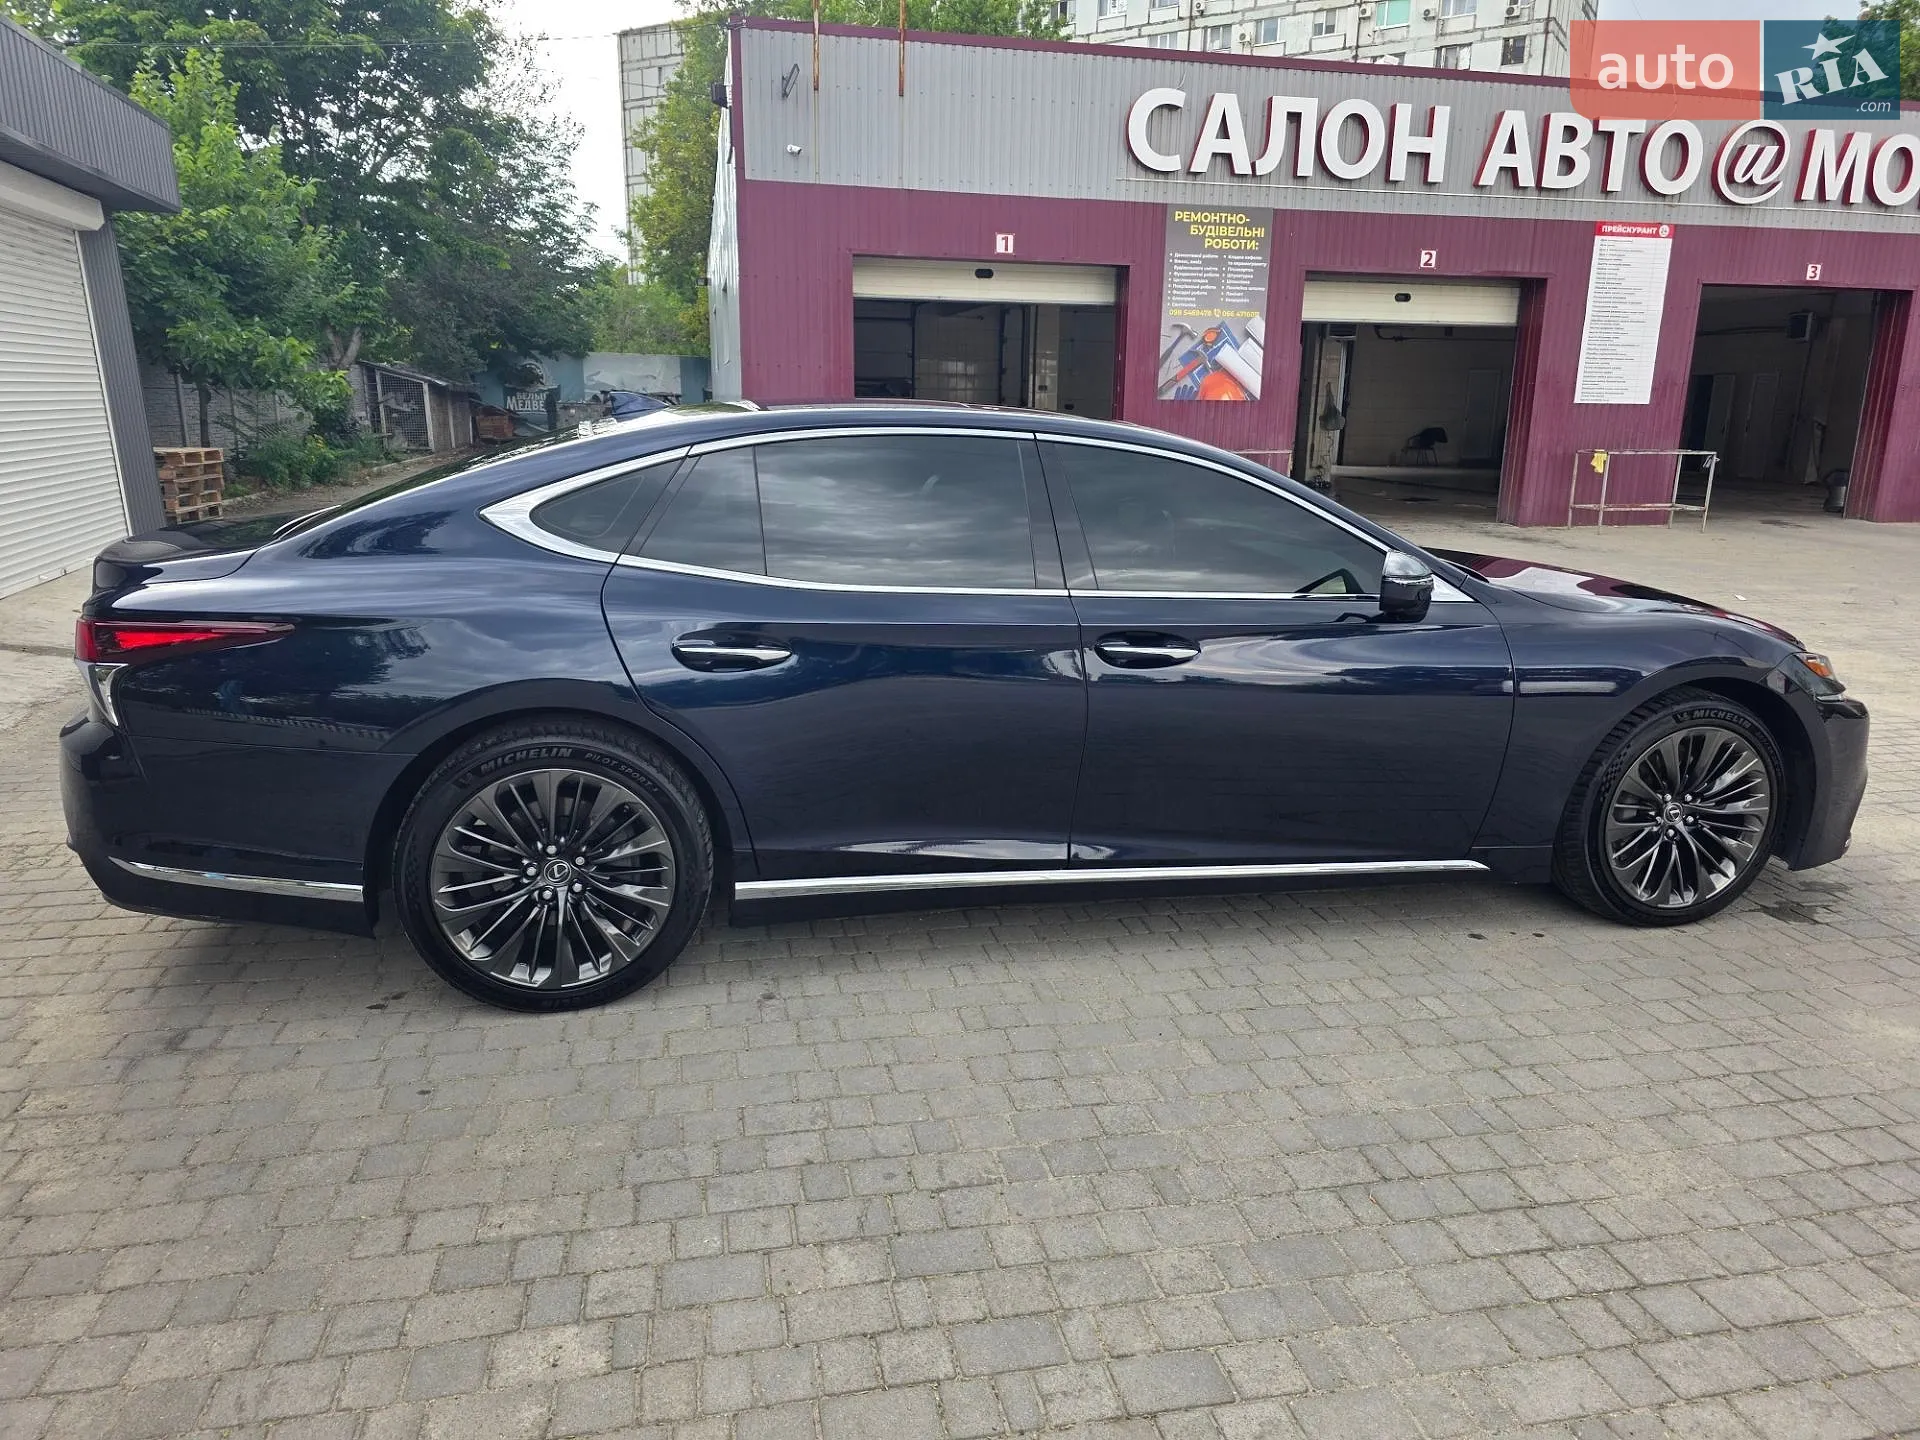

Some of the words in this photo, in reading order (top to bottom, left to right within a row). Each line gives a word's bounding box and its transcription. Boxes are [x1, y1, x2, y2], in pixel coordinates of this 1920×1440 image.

[1126, 86, 1451, 184] САЛОН
[1174, 211, 1250, 224] РЕМОНТНО-
[1190, 224, 1265, 238] БУДІВЕЛЬНІ
[1601, 224, 1658, 235] ПРЕЙСКУРАНТ
[1001, 235, 1009, 252] 1
[1204, 238, 1260, 251] РОБОТИ:
[1423, 251, 1433, 267] 2
[1808, 265, 1818, 279] 3
[506, 396, 546, 411] МЕДВЕ
[1693, 709, 1752, 729] MICHELIN
[480, 748, 573, 775] MICHELIN
[584, 752, 619, 766] PILOT
[619, 764, 653, 786] SPORT
